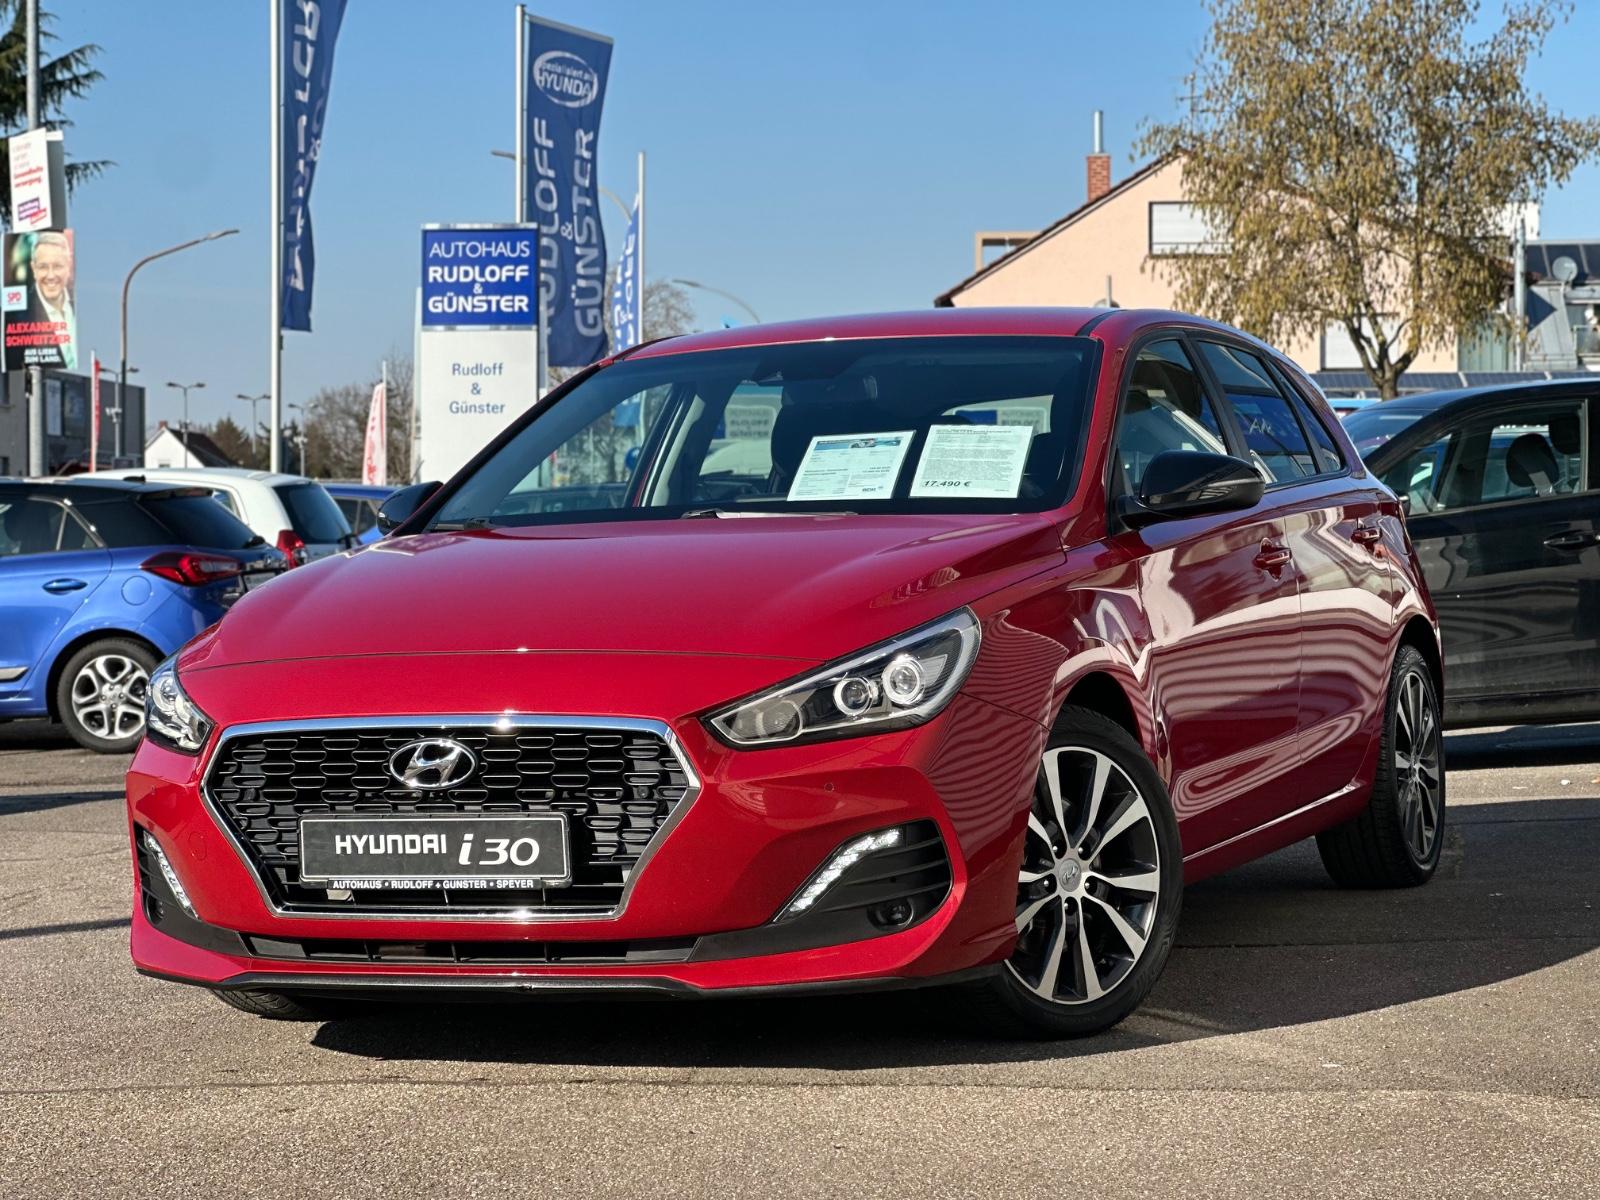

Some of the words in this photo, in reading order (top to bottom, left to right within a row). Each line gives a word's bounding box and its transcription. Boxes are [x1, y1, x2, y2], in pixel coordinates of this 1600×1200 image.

[570, 128, 604, 338] GÜNSTER
[428, 241, 531, 258] AUTOHAUS
[428, 265, 530, 283] RUDLOFF
[473, 282, 483, 294] &
[7, 291, 21, 305] SPD
[428, 292, 530, 313] GÜNSTER
[6, 322, 68, 334] ALEXANDER
[6, 334, 72, 347] SCHWEITZER
[451, 362, 505, 376] Rudloff
[470, 382, 482, 395] &
[448, 400, 506, 414] Günster
[923, 480, 961, 488] 17.490
[335, 834, 447, 855] HYUNDAI
[332, 880, 382, 889] AUTOHAUS
[391, 880, 434, 889] RUDLOFF
[496, 880, 534, 889] SPEYER
